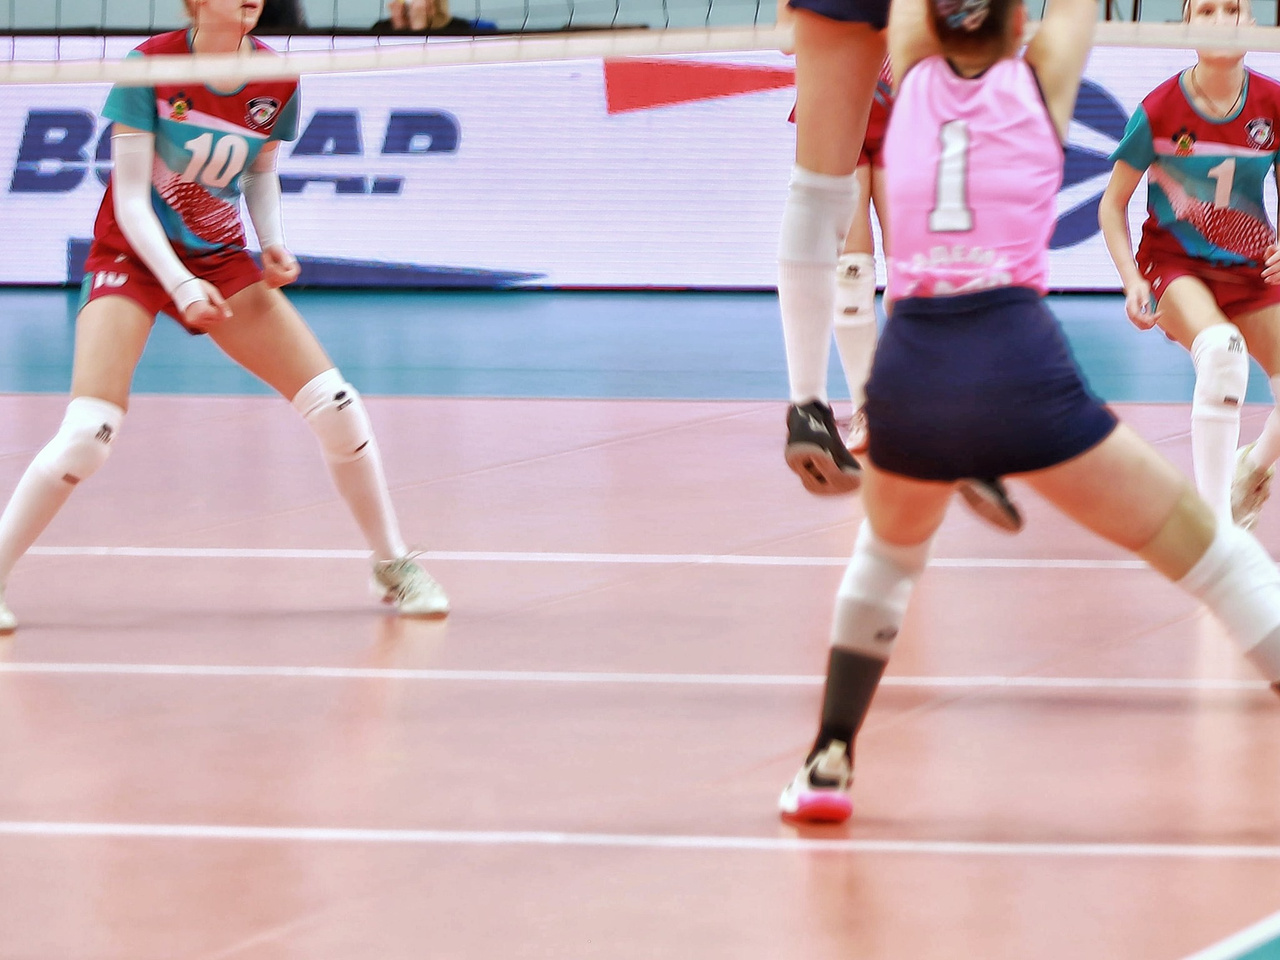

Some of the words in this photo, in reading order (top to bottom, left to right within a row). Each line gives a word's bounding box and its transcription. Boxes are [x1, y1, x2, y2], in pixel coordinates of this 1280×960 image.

[184, 132, 250, 189] 10
[928, 120, 975, 232] 1
[1207, 157, 1236, 211] 1
